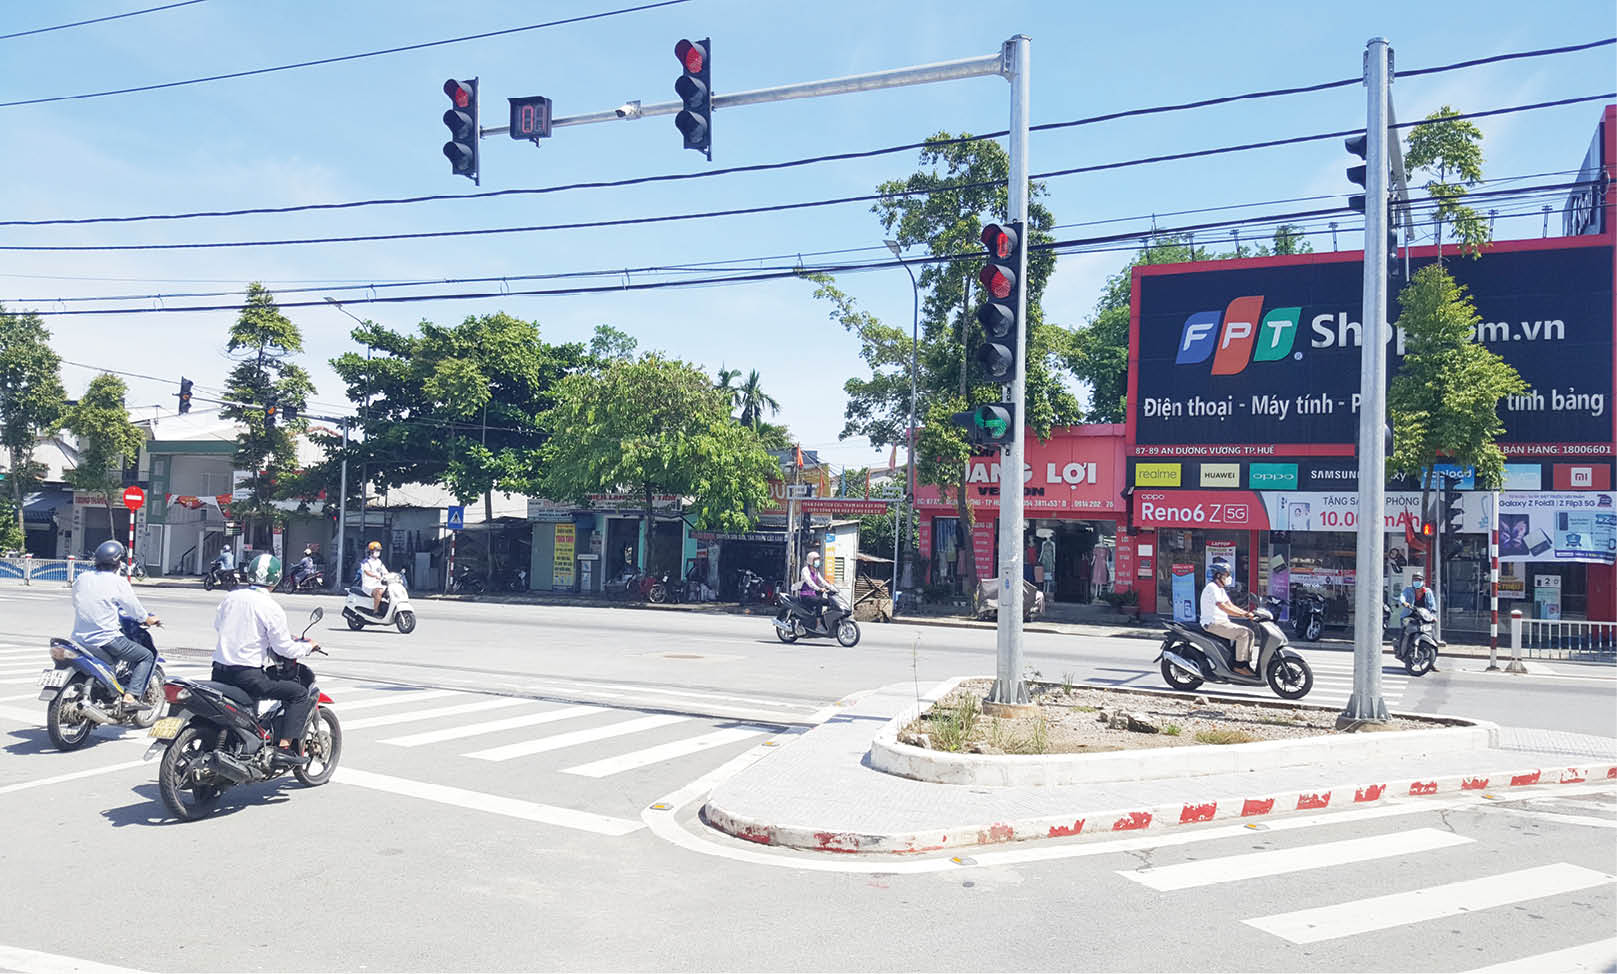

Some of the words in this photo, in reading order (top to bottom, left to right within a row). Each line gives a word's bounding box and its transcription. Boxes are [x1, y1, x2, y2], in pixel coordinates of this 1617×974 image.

[1182, 320, 1293, 351] FPT
[1144, 397, 1182, 420] Điện
[1187, 395, 1233, 421] thoại
[1251, 395, 1289, 420] Máy
[1296, 393, 1333, 415] tính
[1551, 387, 1604, 417] bảng
[1562, 445, 1611, 454] 18006601
[1047, 462, 1098, 490] LỢI
[1138, 469, 1177, 479] realme
[1311, 470, 1360, 479] SAMSUN
[1323, 496, 1348, 507] TẶNG
[1386, 495, 1420, 506] PHÒNG
[1499, 500, 1527, 508] Galaxy
[1141, 503, 1205, 521] Reno6
[1209, 504, 1221, 522] Z
[1226, 508, 1246, 519] 5G
